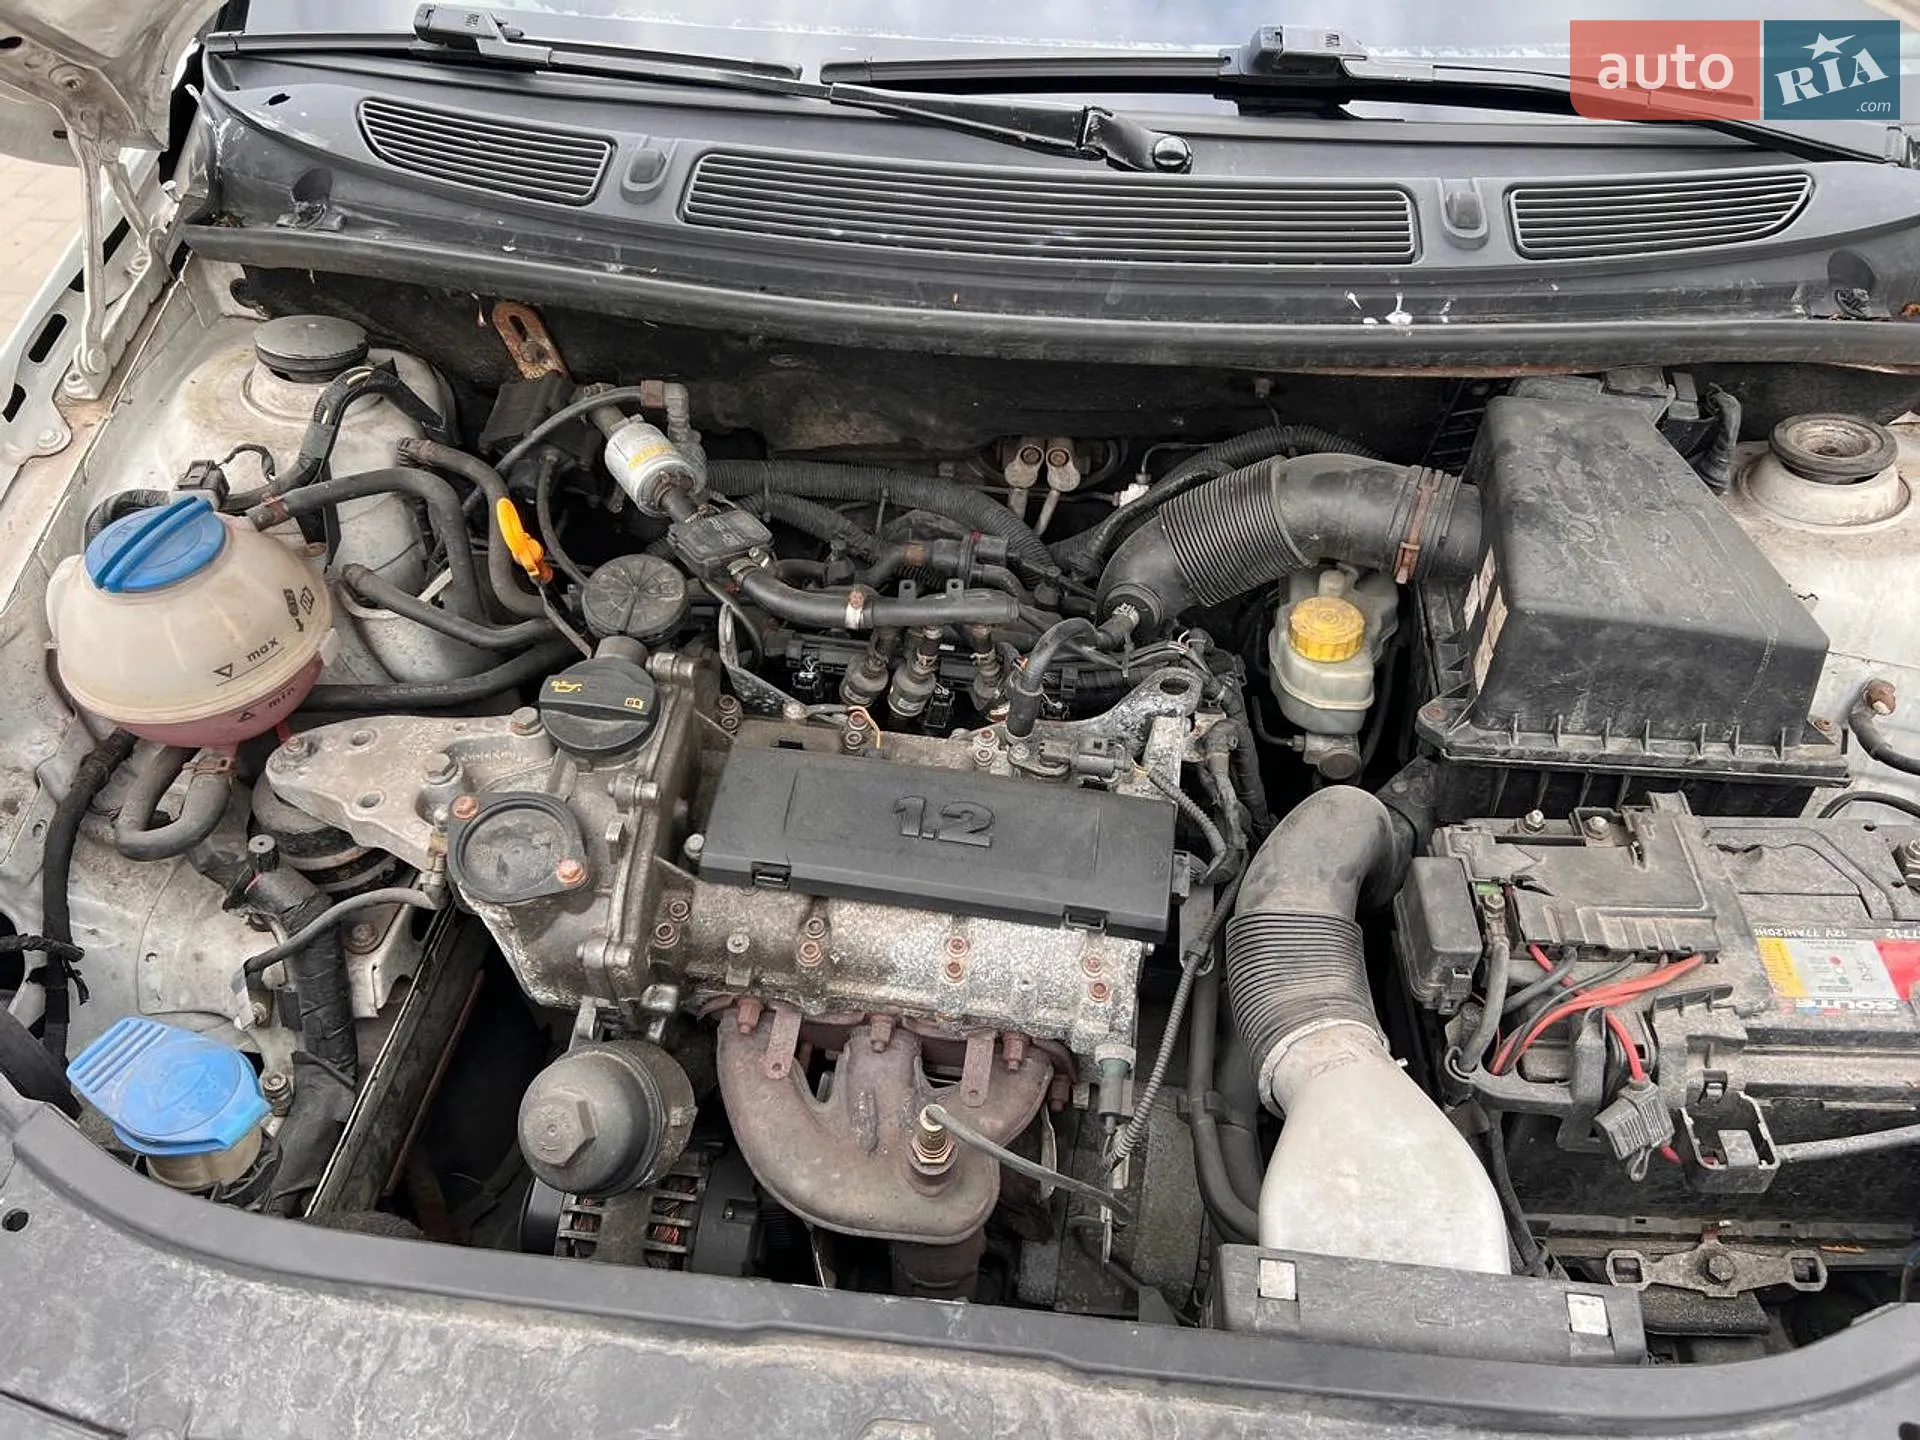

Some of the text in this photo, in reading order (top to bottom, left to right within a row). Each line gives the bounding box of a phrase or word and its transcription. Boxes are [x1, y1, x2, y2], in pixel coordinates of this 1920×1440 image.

[247, 637, 279, 662] max
[268, 687, 295, 708] min
[893, 795, 996, 848] 1.2
